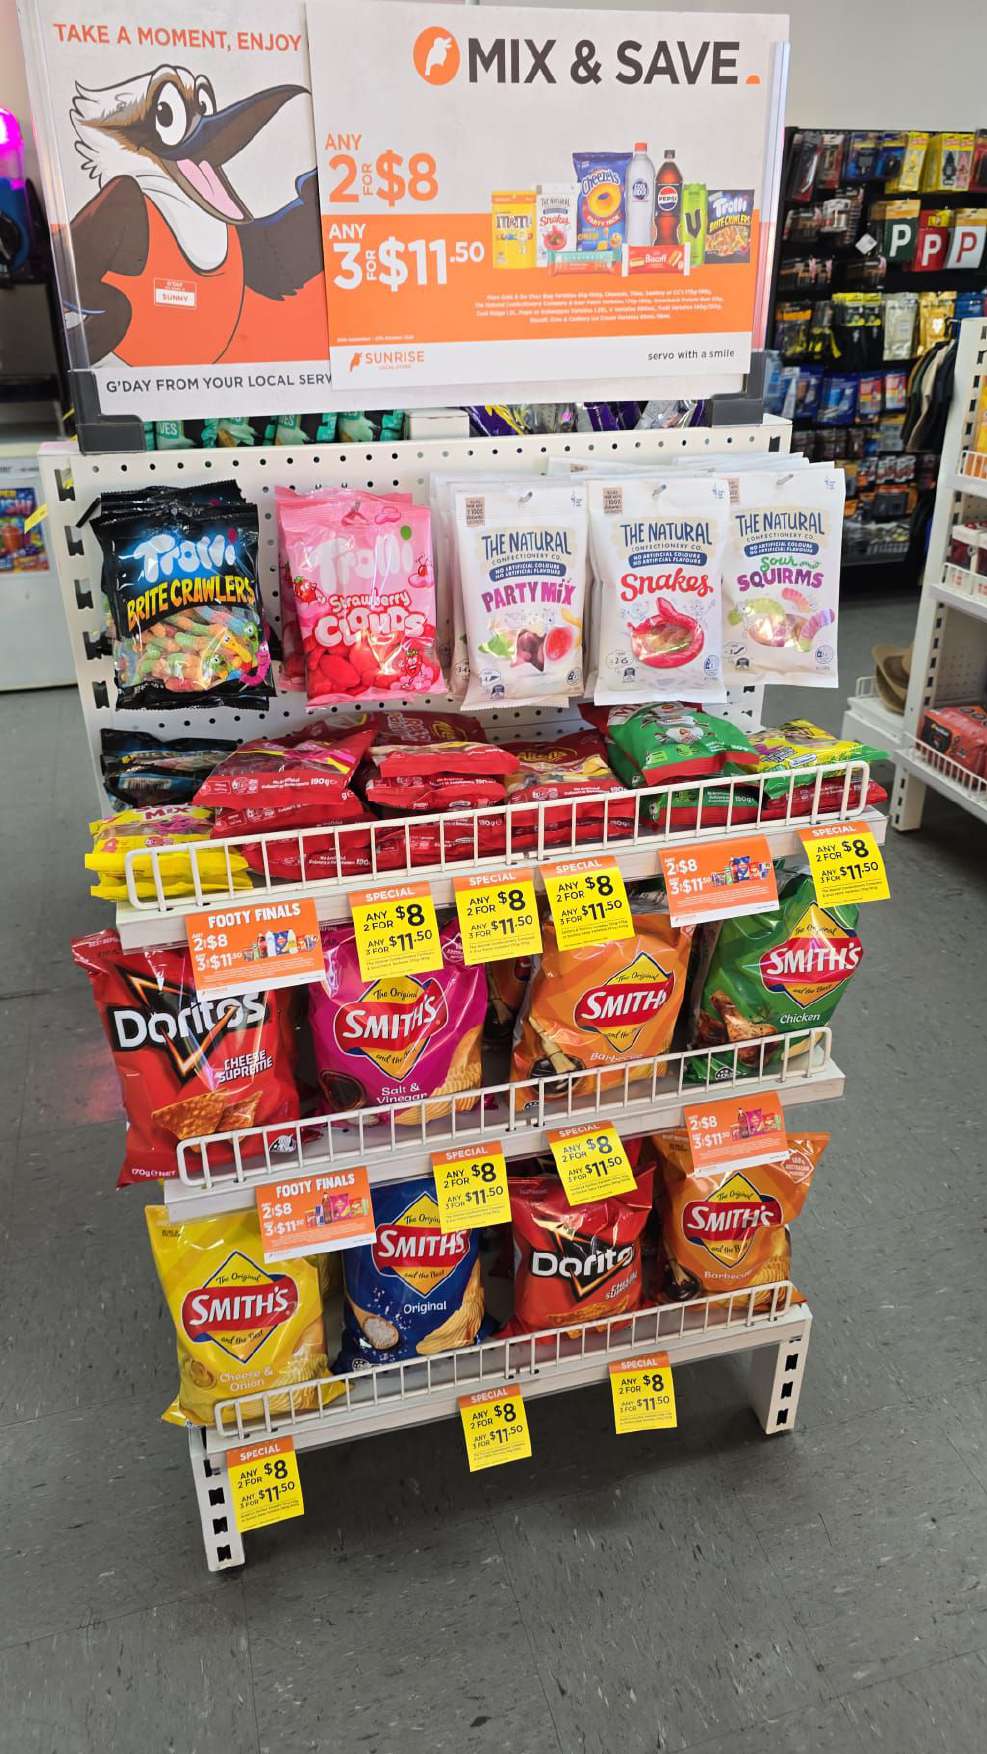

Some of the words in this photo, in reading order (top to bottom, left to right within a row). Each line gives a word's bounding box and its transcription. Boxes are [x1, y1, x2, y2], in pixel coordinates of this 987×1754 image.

[54, 24, 109, 44] TAKE
[117, 27, 132, 45] A
[137, 27, 231, 51] MOMENT,
[238, 32, 302, 52] ENJOY
[468, 38, 557, 84] MIX
[570, 39, 602, 84] &
[325, 134, 362, 151] ANY
[329, 154, 359, 203] 2
[362, 164, 372, 196] FOR
[376, 149, 438, 208] $8
[713, 197, 748, 219] Trolli
[328, 224, 366, 240] ANY
[889, 224, 912, 258] P
[922, 234, 942, 267] P
[956, 232, 977, 262] P
[332, 243, 362, 290] 3
[366, 250, 376, 280] FOR
[378, 236, 484, 292] $11.50
[645, 254, 668, 264] Biscoff
[365, 351, 424, 364] SUNRISE
[648, 352, 674, 360] servo
[678, 349, 698, 360] with
[710, 349, 734, 358] smile
[106, 381, 151, 393] G'DAY
[157, 378, 200, 392] FROM
[203, 376, 244, 390] YOUR
[248, 374, 294, 388] LOCAL
[736, 514, 760, 536] THE
[763, 512, 824, 535] NATURAL
[620, 523, 644, 547] THE
[648, 522, 712, 546] NATURAL
[125, 528, 237, 583] Trolli
[481, 534, 506, 560] THE
[510, 531, 572, 555] NATURAL
[312, 526, 414, 593] Trolli
[620, 567, 714, 602] Snakes
[737, 567, 824, 592] SQUIRMS
[127, 580, 169, 632] BRITE
[170, 575, 256, 609] CRAWLERS
[329, 587, 412, 613] Strawberry
[481, 581, 539, 613] PARTY
[812, 826, 856, 836] SPECIAL
[816, 854, 822, 862] 2
[824, 852, 842, 860] FOR
[841, 840, 869, 858] $8
[556, 860, 602, 874] SPECIAL
[840, 862, 878, 880] $11.50
[469, 872, 517, 886] SPECIAL
[556, 894, 562, 902] 2
[564, 890, 584, 901] FOR
[585, 876, 614, 896] $8
[558, 881, 579, 892] ANY
[365, 888, 416, 902] SPECIAL
[468, 908, 473, 916] 2
[476, 904, 496, 914] FOR
[498, 889, 526, 910] $8
[470, 896, 490, 906] ANY
[208, 911, 251, 928] FOOTY
[255, 904, 301, 922] FINALS
[364, 924, 369, 932] 2
[372, 920, 394, 930] FOR
[396, 904, 425, 926] $8
[366, 910, 388, 922] ANY
[562, 908, 578, 917] ANY
[566, 916, 582, 924] FOR
[582, 900, 622, 920] $11.50
[491, 915, 532, 935] $11.50
[368, 938, 384, 948] ANY
[372, 946, 390, 954] FOR
[389, 930, 432, 951] $11.50
[767, 942, 862, 975] SMITH'S
[114, 994, 266, 1048] Doritos
[343, 994, 436, 1040] SMITH'S
[780, 1012, 820, 1024] Chicken
[218, 1056, 272, 1084] SUPREME
[224, 1050, 266, 1071] CHEESE
[376, 1093, 428, 1104] Vinegar
[382, 1086, 407, 1096] Salt
[410, 1083, 420, 1092] &
[559, 1124, 600, 1138] SPECIAL
[446, 1147, 488, 1160] SPECIAL
[564, 1144, 581, 1154] ANY
[570, 1152, 586, 1160] FOR
[586, 1136, 612, 1154] $8
[446, 1170, 464, 1178] ANY
[452, 1178, 470, 1187] FOR
[472, 1162, 496, 1182] $8
[585, 1156, 622, 1177] $11.50
[276, 1180, 312, 1198] FOOTY
[316, 1174, 356, 1191] FINALS
[466, 1186, 504, 1205] $11.50
[378, 1230, 466, 1258] SMITHS
[216, 1276, 230, 1284] The
[231, 1272, 262, 1283] Original
[190, 1286, 289, 1326] SMITH'S
[404, 1301, 447, 1314] Original
[220, 1335, 234, 1344] and
[236, 1334, 247, 1344] the
[621, 1358, 658, 1369] SPECIAL
[220, 1370, 260, 1383] Cheese
[264, 1366, 274, 1376] &
[622, 1378, 636, 1386] ANY
[642, 1374, 664, 1391] $8
[230, 1380, 265, 1392] Onion
[471, 1388, 508, 1404] SPECIAL
[637, 1396, 670, 1410] $11.50
[472, 1410, 488, 1420] ANY
[478, 1418, 493, 1428] FOR
[494, 1403, 516, 1422] $8
[489, 1424, 522, 1444] $11.50
[240, 1444, 280, 1462] SPECIAL
[240, 1468, 258, 1480] ANY
[245, 1476, 262, 1486] FOR
[264, 1460, 288, 1479] $8
[258, 1481, 295, 1502] $11.50
